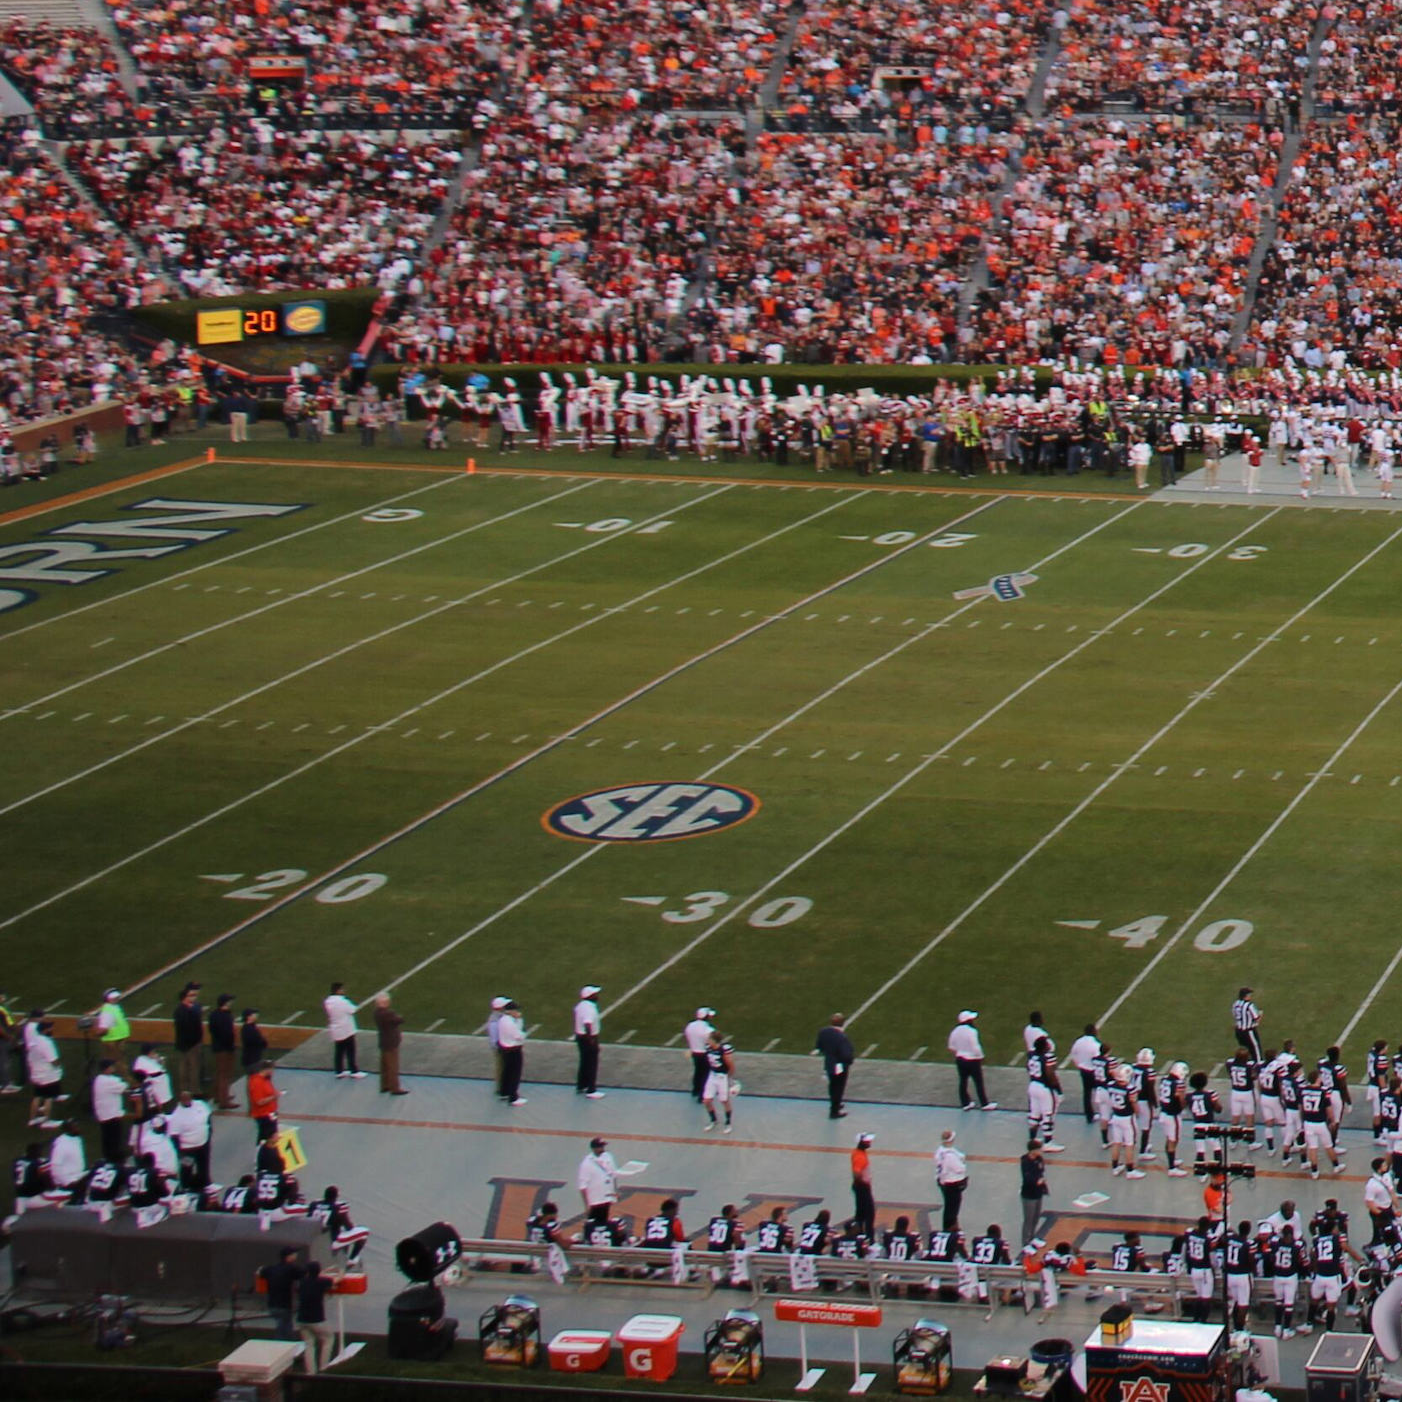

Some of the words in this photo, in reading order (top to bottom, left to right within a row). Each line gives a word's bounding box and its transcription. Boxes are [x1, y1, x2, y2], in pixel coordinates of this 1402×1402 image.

[243, 310, 278, 335] 20
[362, 508, 425, 523] G
[873, 531, 979, 548] 20
[1167, 543, 1268, 561] 30
[561, 784, 743, 839] SEC
[222, 869, 389, 903] 20
[661, 891, 814, 927] 30
[1108, 915, 1254, 952] 40
[1191, 1099, 1208, 1116] 41
[1303, 1095, 1321, 1112] 67
[284, 1136, 295, 1160] 1
[91, 1167, 117, 1188] 29
[128, 1173, 149, 1193] 91
[257, 1179, 279, 1199] 55
[225, 1190, 247, 1209] 44
[647, 1220, 669, 1239] 25
[709, 1223, 729, 1242] 30
[759, 1229, 780, 1248] 36
[801, 1227, 822, 1247] 27
[931, 1235, 948, 1256] 31
[975, 1243, 995, 1263] 33
[1227, 1246, 1240, 1265] 11
[1316, 1241, 1334, 1260] 12
[1112, 1251, 1130, 1271] 15
[798, 1309, 856, 1323] GATORADE
[566, 1353, 581, 1368] G
[629, 1348, 653, 1372] G
